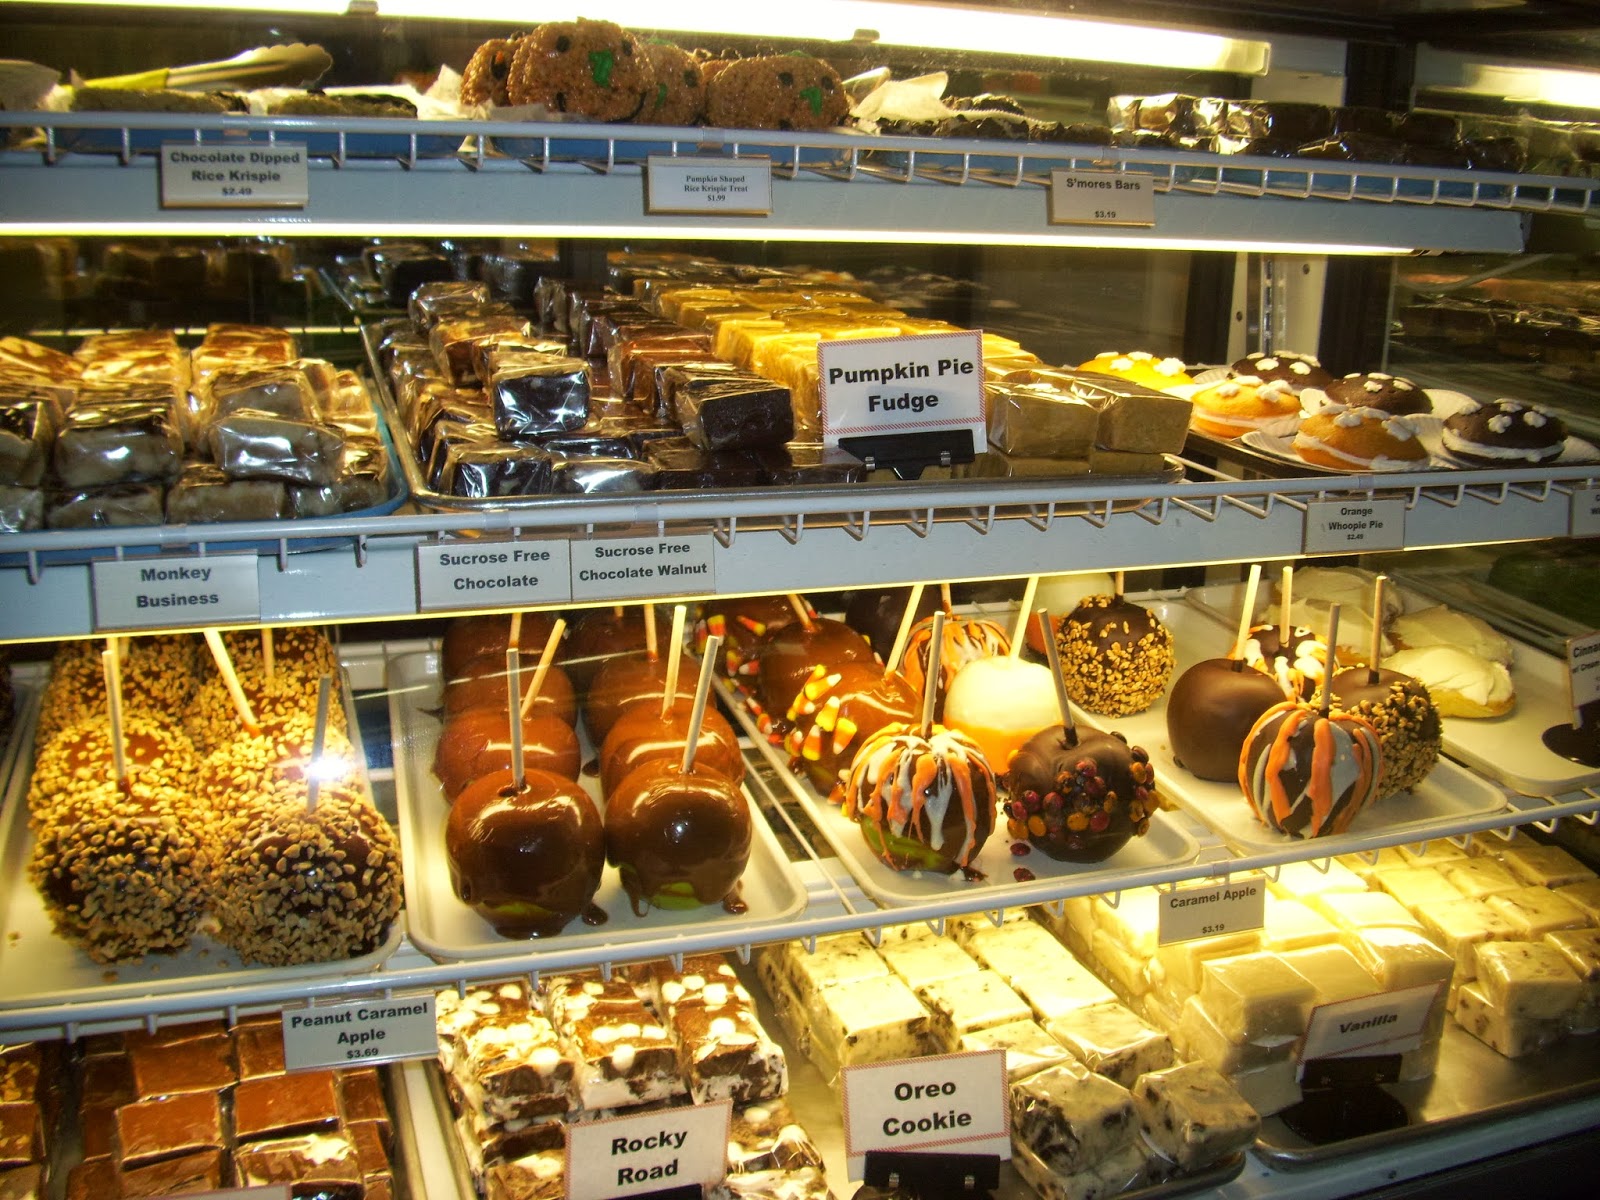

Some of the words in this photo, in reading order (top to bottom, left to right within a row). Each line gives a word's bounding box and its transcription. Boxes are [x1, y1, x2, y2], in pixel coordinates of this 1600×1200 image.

[170, 152, 245, 163] Chocolate
[250, 152, 300, 164] Dipped
[191, 170, 225, 181] Rice
[229, 170, 281, 183] Krispie
[686, 175, 718, 183] Pumpkin
[720, 175, 745, 183] Shaped
[1066, 178, 1112, 189] S'mores
[1115, 180, 1141, 190] Bars
[221, 187, 252, 196] $2.49
[701, 185, 727, 193] Krispie
[707, 194, 725, 202] $1.99
[1094, 210, 1116, 218] $3.19
[829, 362, 929, 384] Pumpkin
[937, 358, 974, 376] Pie
[868, 393, 939, 413] Fudge
[1340, 507, 1373, 516] Orange
[1328, 520, 1367, 531] Whoopie
[1369, 520, 1384, 529] Pie
[440, 553, 508, 566] Sucrose
[513, 550, 551, 562] Free
[595, 546, 654, 558] Sucrose
[658, 543, 690, 554] Free
[140, 567, 212, 581] Monkey
[579, 567, 654, 581] Chocolate
[657, 563, 708, 577] Walnut
[454, 574, 539, 590] Chocolate
[136, 593, 219, 608] Business
[1170, 891, 1220, 909] Caramel
[1223, 887, 1257, 901] Apple
[1202, 923, 1225, 934] $3.19
[291, 1011, 352, 1028] Peanut
[357, 1002, 428, 1021] Caramel
[1339, 1014, 1398, 1033] Vanilla
[337, 1029, 386, 1045] Apple
[347, 1047, 379, 1059] $3.69
[894, 1081, 957, 1101] Oreo
[882, 1110, 972, 1136] Cookie
[611, 1131, 688, 1155] Rocky
[617, 1159, 679, 1186] Road
